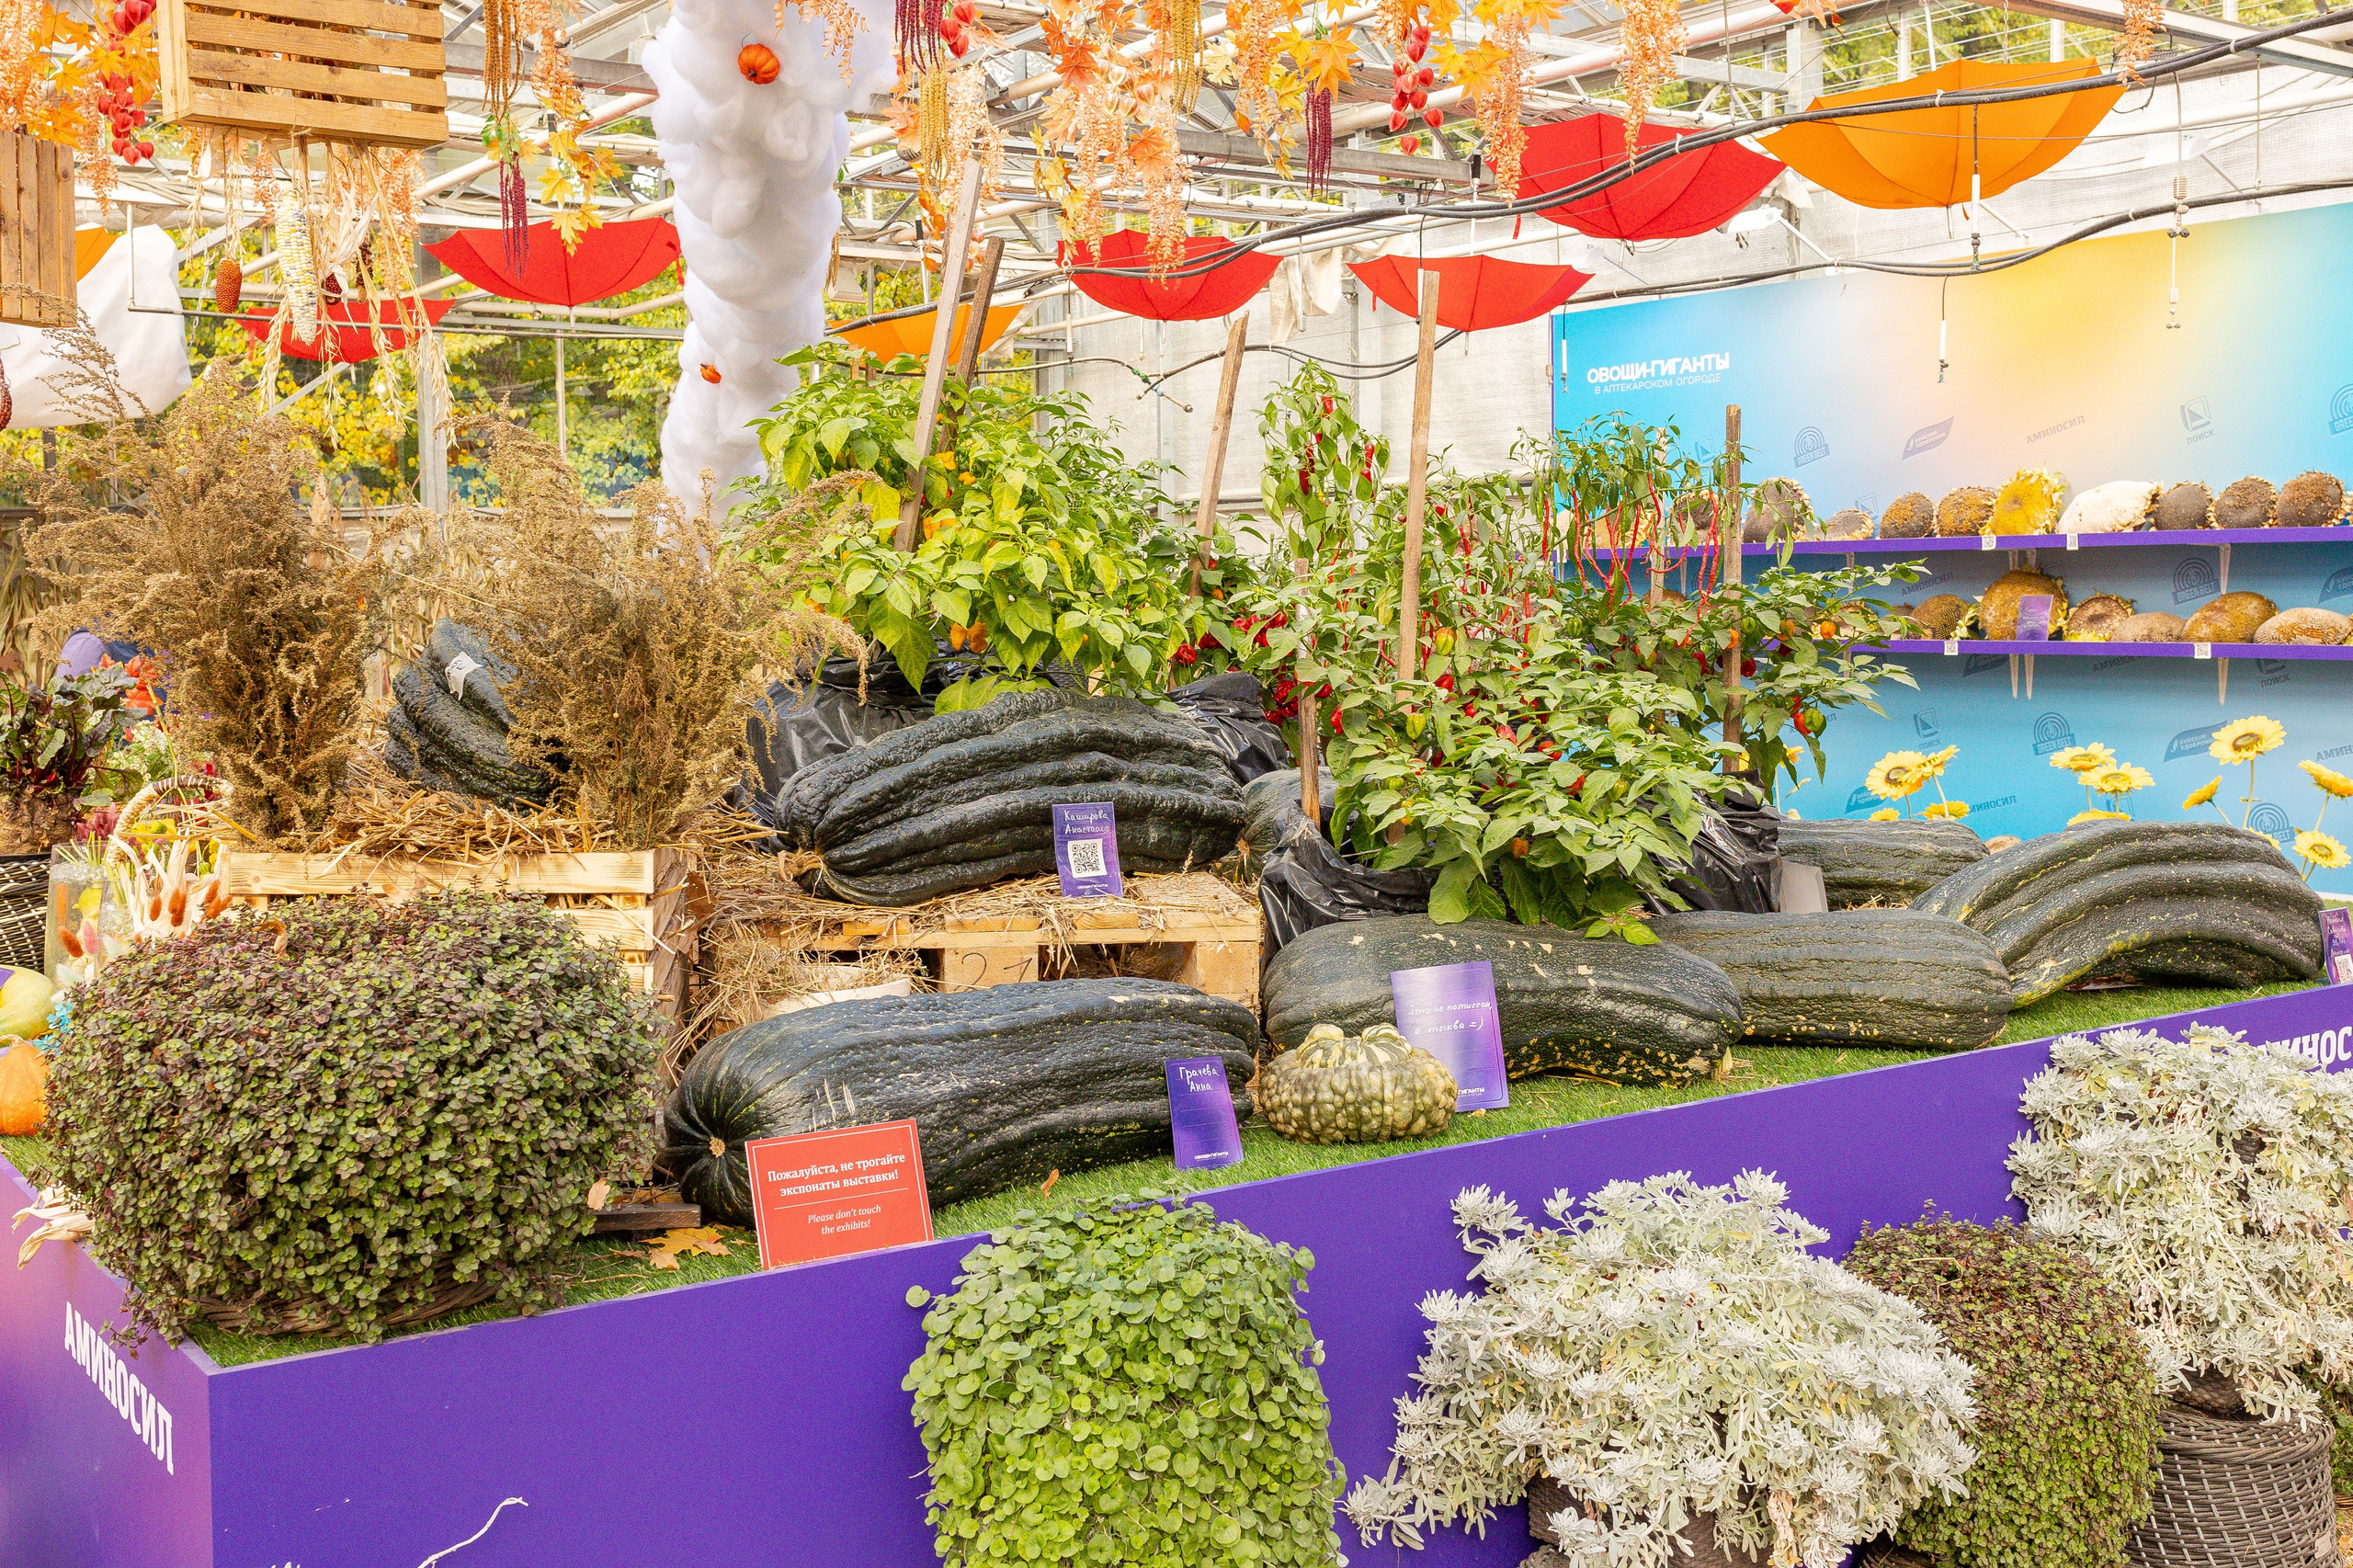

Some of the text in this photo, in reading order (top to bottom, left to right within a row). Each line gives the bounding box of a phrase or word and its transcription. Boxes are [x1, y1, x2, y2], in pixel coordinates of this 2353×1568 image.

[1586, 352, 1730, 384] ОВОЩИ-ГИГАНТЫ
[1595, 372, 1722, 394] В АПТЕКАРСКОМ ОГОРОДЕ
[2026, 415, 2086, 445] АМИНОСИЛ
[2335, 416, 2353, 432] GREE
[2187, 429, 2216, 446] ПОИСК
[1797, 446, 1827, 467] GREEN BELT
[2177, 581, 2216, 603] GREEN BELT
[2260, 674, 2291, 688] ПОИСК
[1918, 738, 1942, 750] ПОИСК
[2037, 739, 2056, 754] GREEN
[2316, 744, 2353, 762] АМИН
[1968, 795, 2018, 814] МИНОСИЛ
[1414, 1027, 1421, 1036] а
[1428, 1019, 1465, 1034] тыква
[1189, 1081, 1213, 1093] Анна
[1458, 1086, 1485, 1095] ГИГАНТЫ
[767, 1153, 906, 1183] Пожалуйста, не трогайте
[779, 1168, 900, 1197] экспонаты выставки!
[807, 1212, 835, 1224] Please
[858, 1204, 882, 1217] touch
[821, 1219, 871, 1235] the exhibits!
[64, 1301, 175, 1476] АМИНОСИЛ
